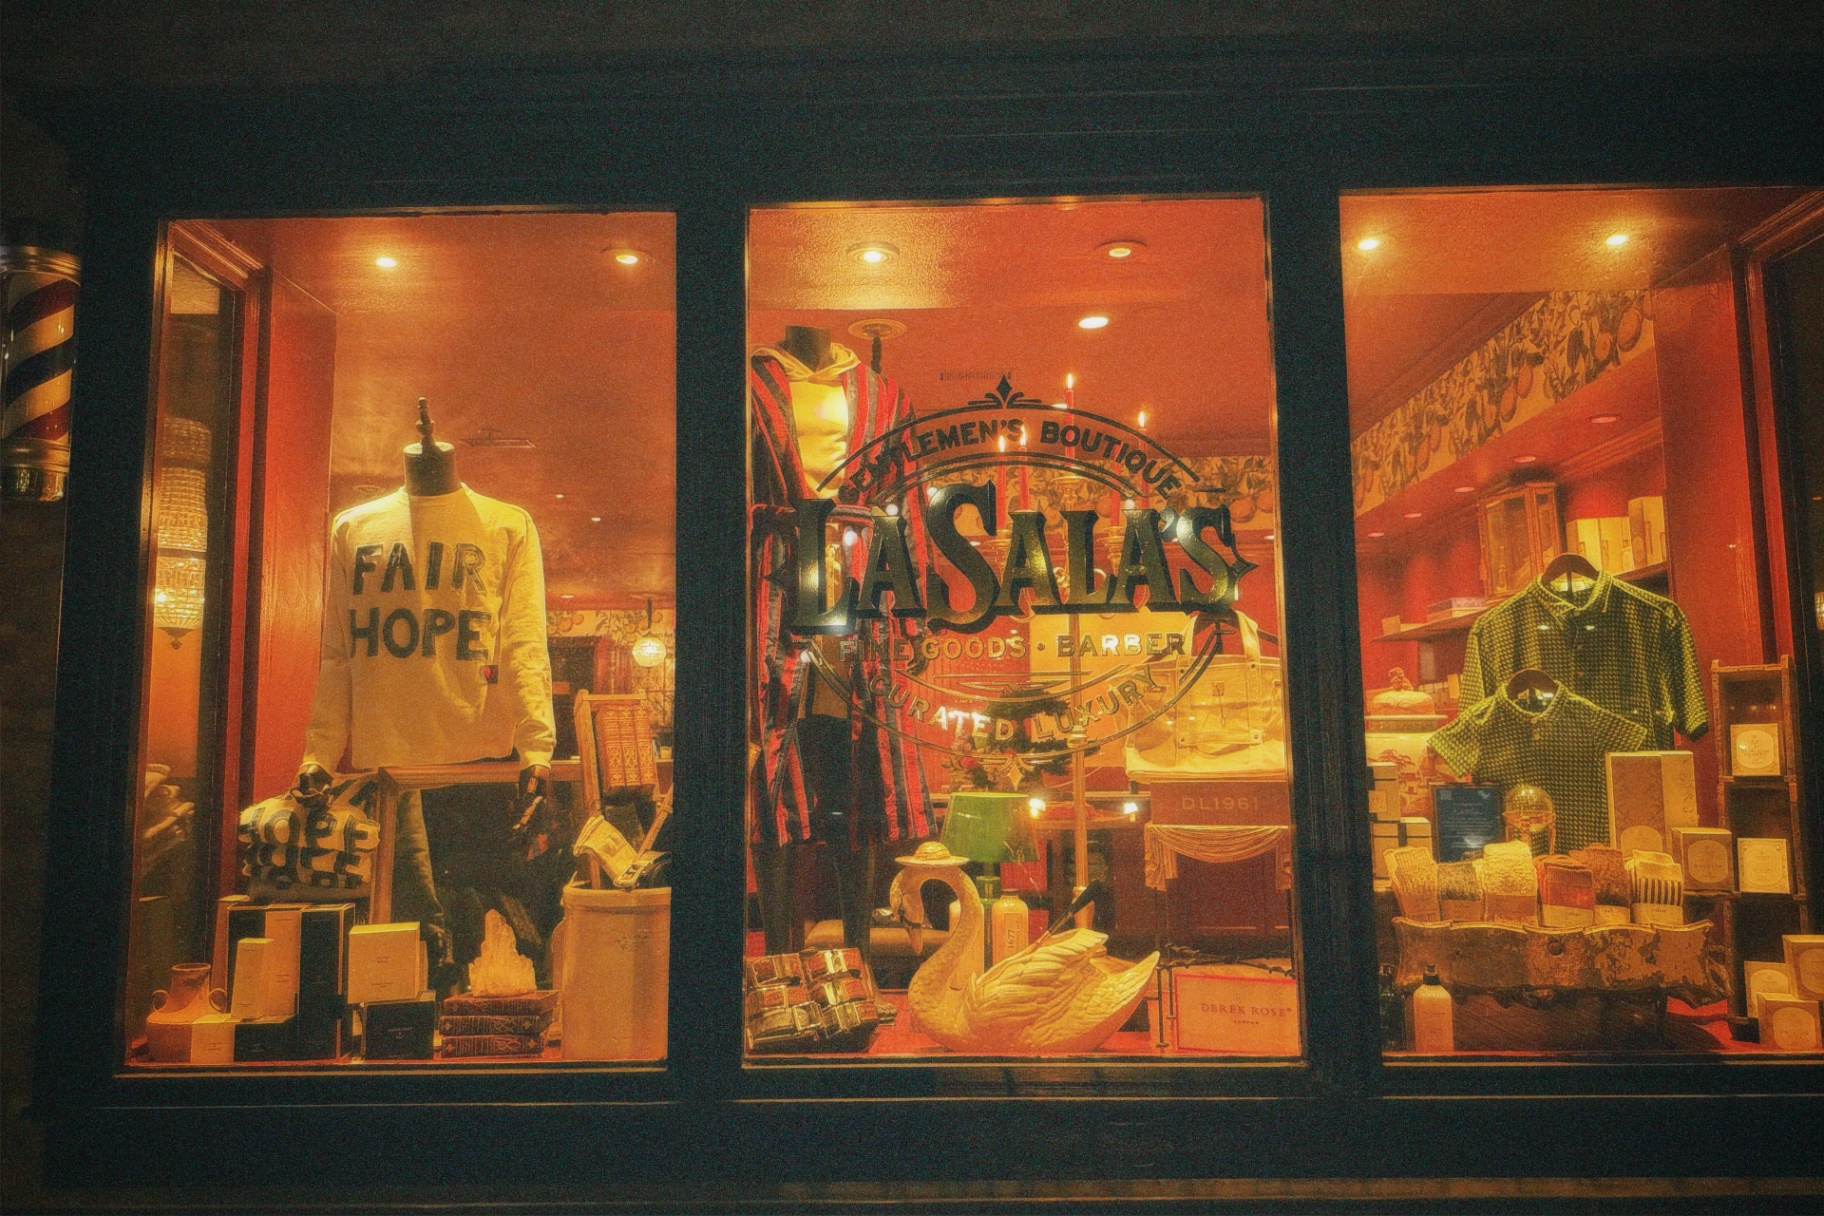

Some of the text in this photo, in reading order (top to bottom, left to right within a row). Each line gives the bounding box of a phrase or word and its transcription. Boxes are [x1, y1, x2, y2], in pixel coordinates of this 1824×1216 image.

[838, 418, 1183, 503] GENTLEMEN'S BOUTIQUE
[353, 541, 488, 597] FAIR
[349, 606, 493, 661] HOPE
[839, 632, 1187, 662] FINE GOODS BARBER
[869, 664, 1161, 742] CURATED LUXURY
[1181, 796, 1259, 811] DL1961
[1006, 929, 1015, 949] 1677
[1201, 1002, 1246, 1015] DEREK
